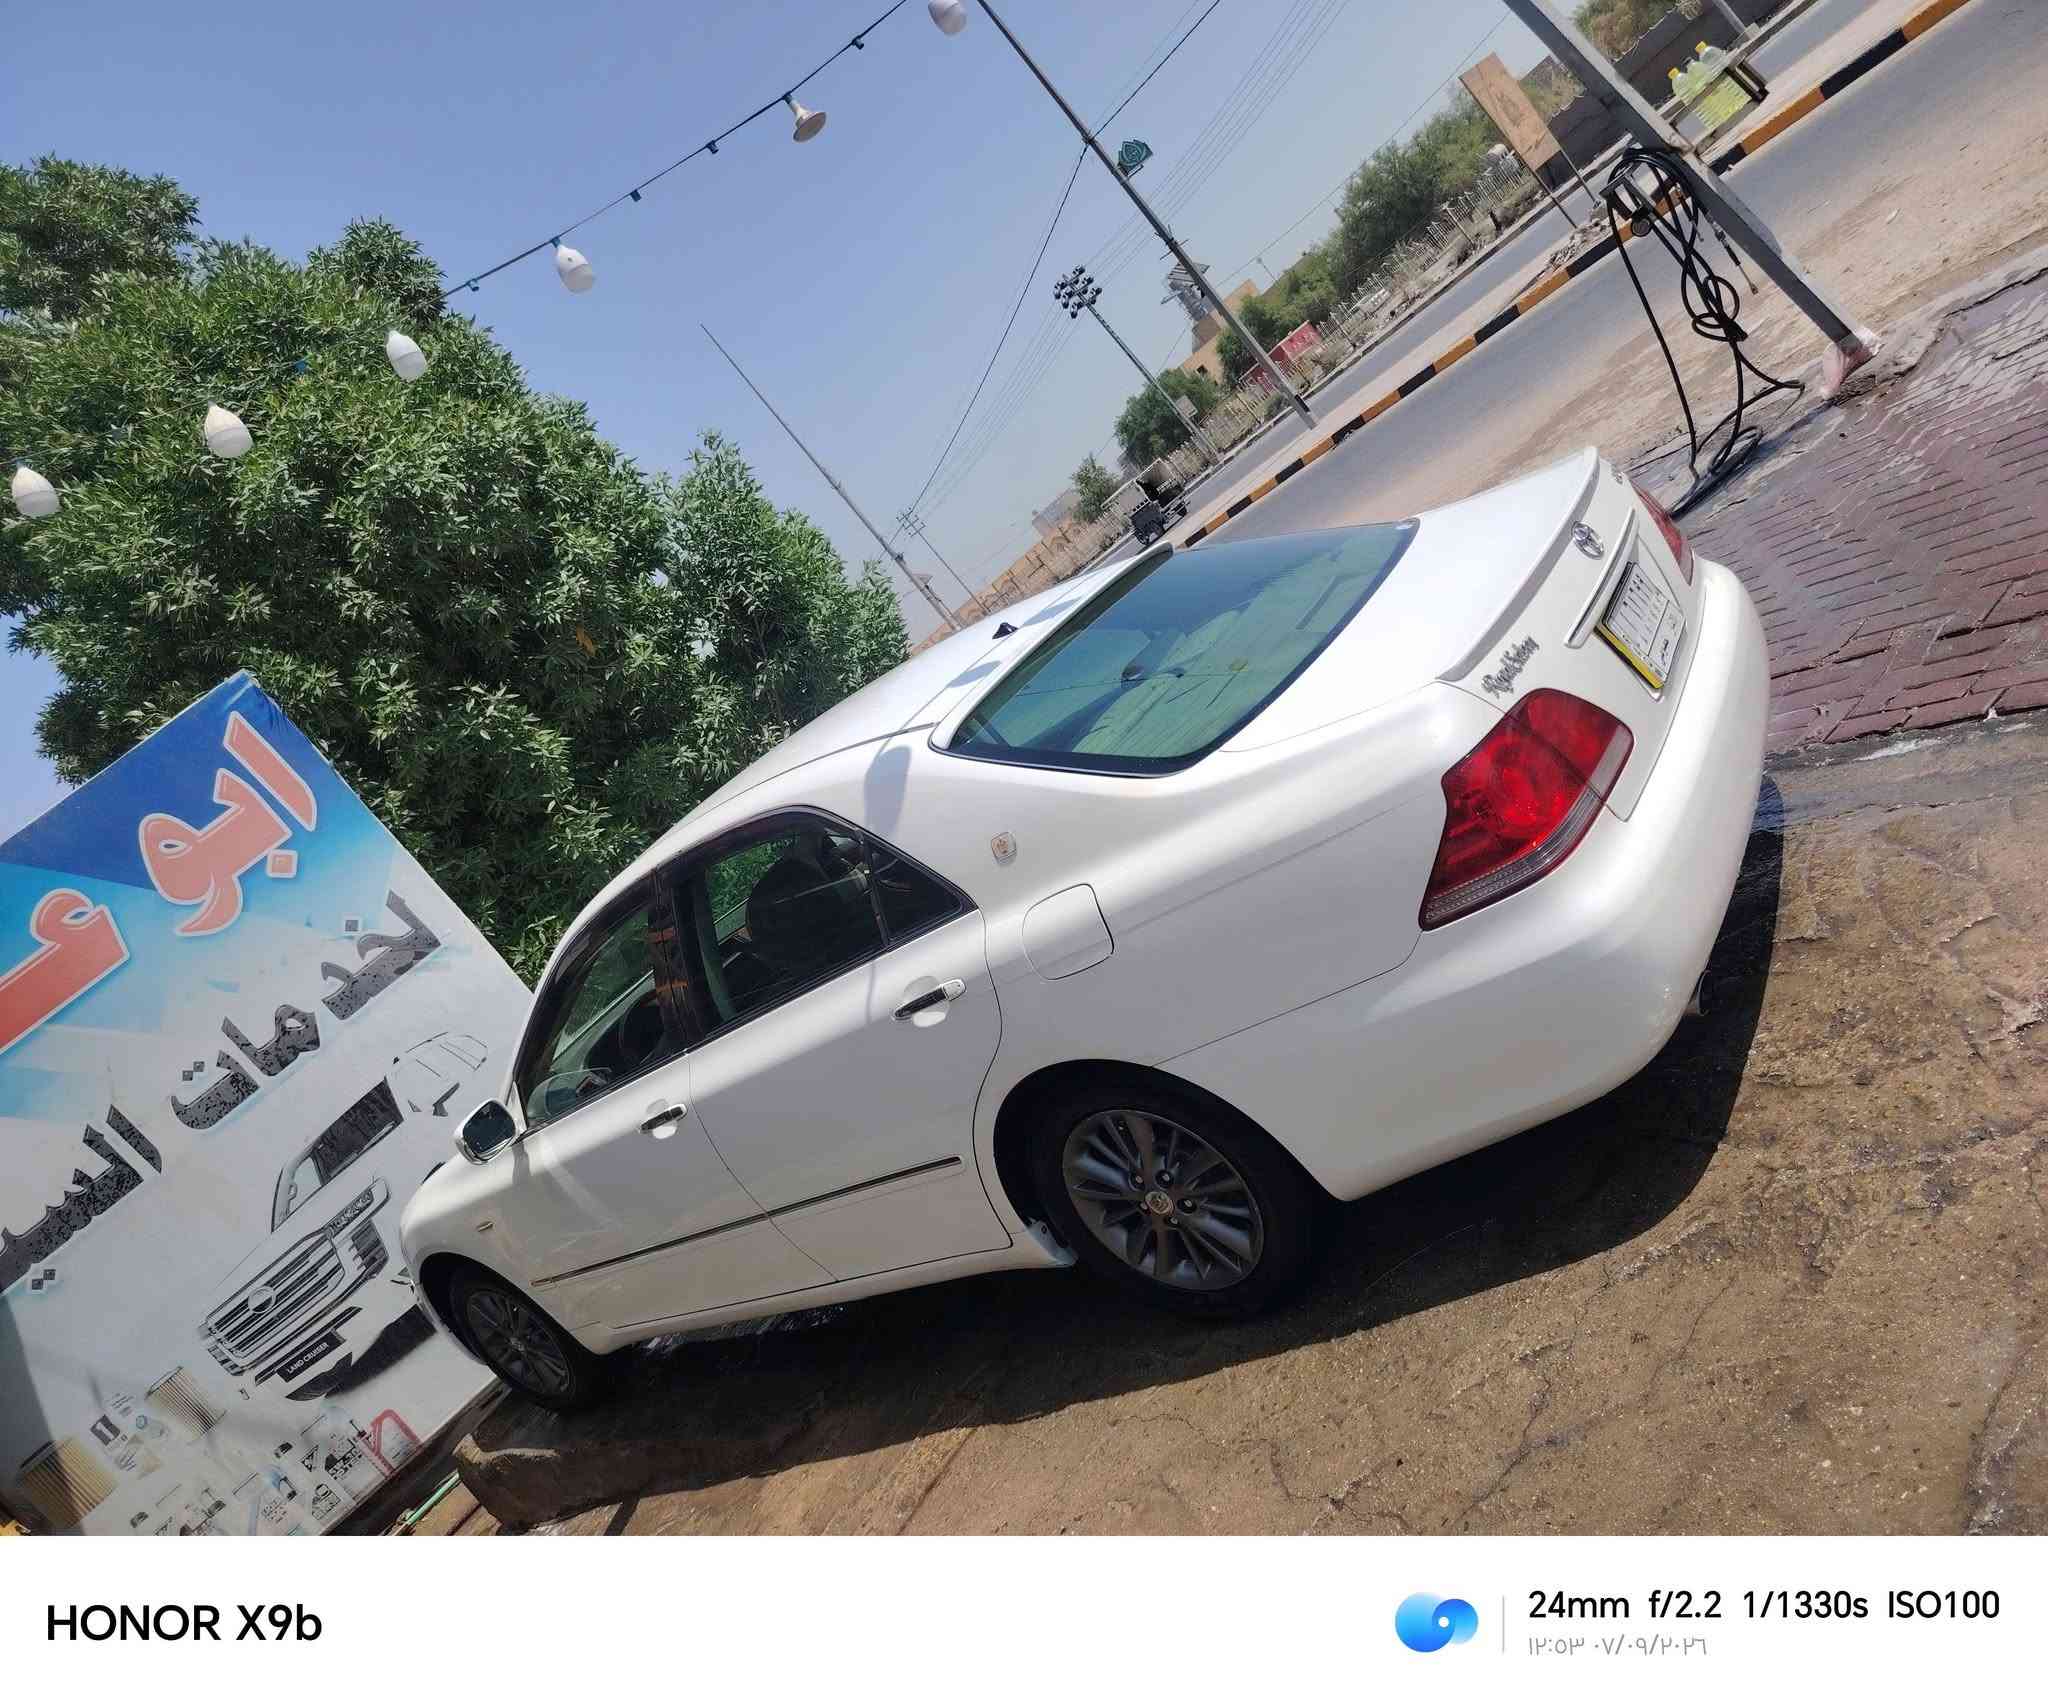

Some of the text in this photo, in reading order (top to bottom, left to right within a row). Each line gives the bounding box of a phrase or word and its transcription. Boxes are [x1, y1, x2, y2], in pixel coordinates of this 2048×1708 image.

[139, 710, 317, 936] ابو
[170, 889, 441, 1130] لخدمات
[286, 1341, 329, 1374] LAND CRUISER
